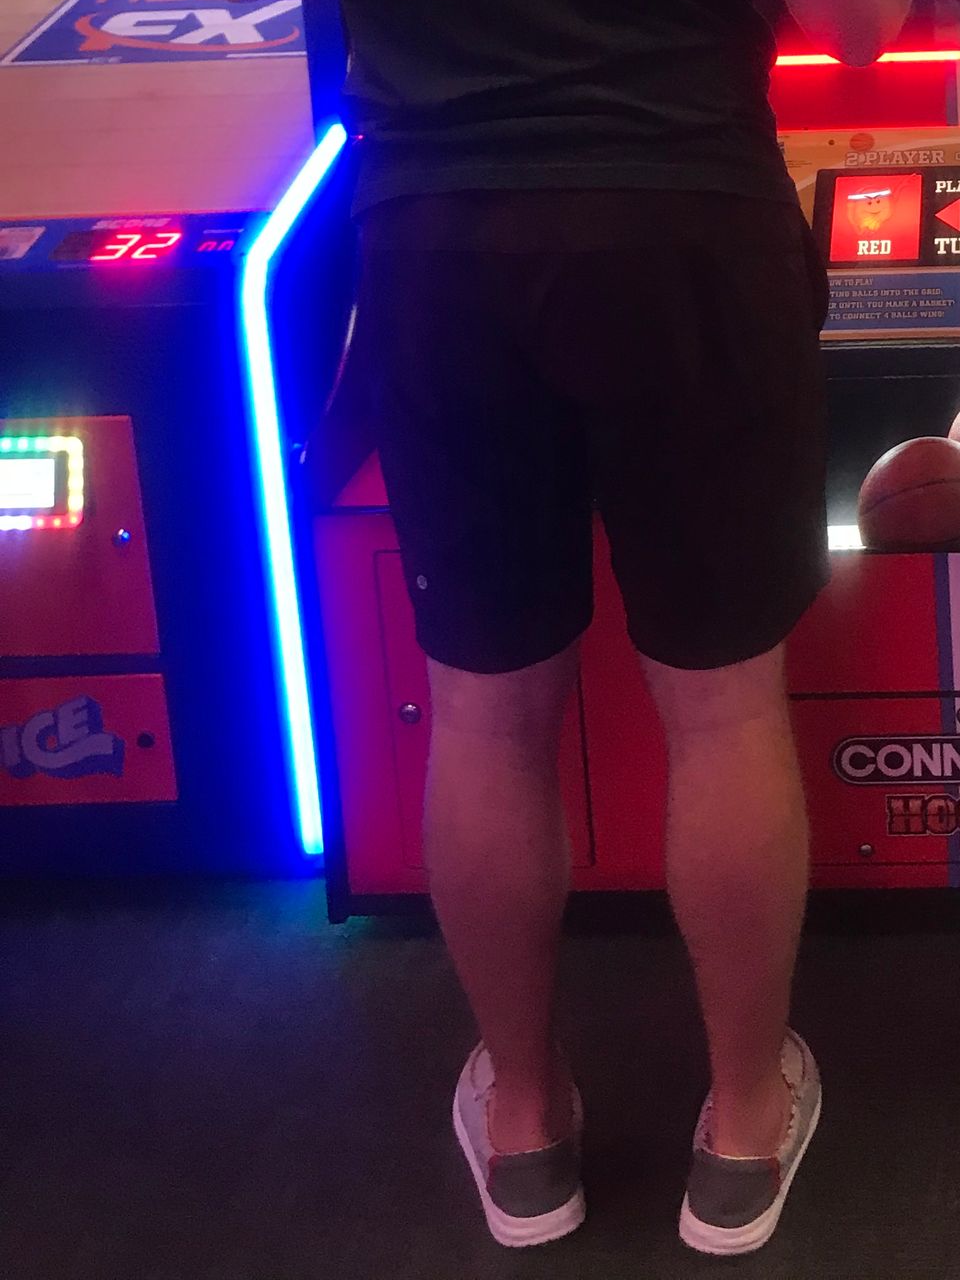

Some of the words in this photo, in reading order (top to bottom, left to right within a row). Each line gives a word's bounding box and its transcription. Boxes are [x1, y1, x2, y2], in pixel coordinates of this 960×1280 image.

[846, 151, 858, 167] 2
[863, 150, 945, 167] PLAYER
[90, 233, 182, 261] 32
[857, 239, 892, 256] RED
